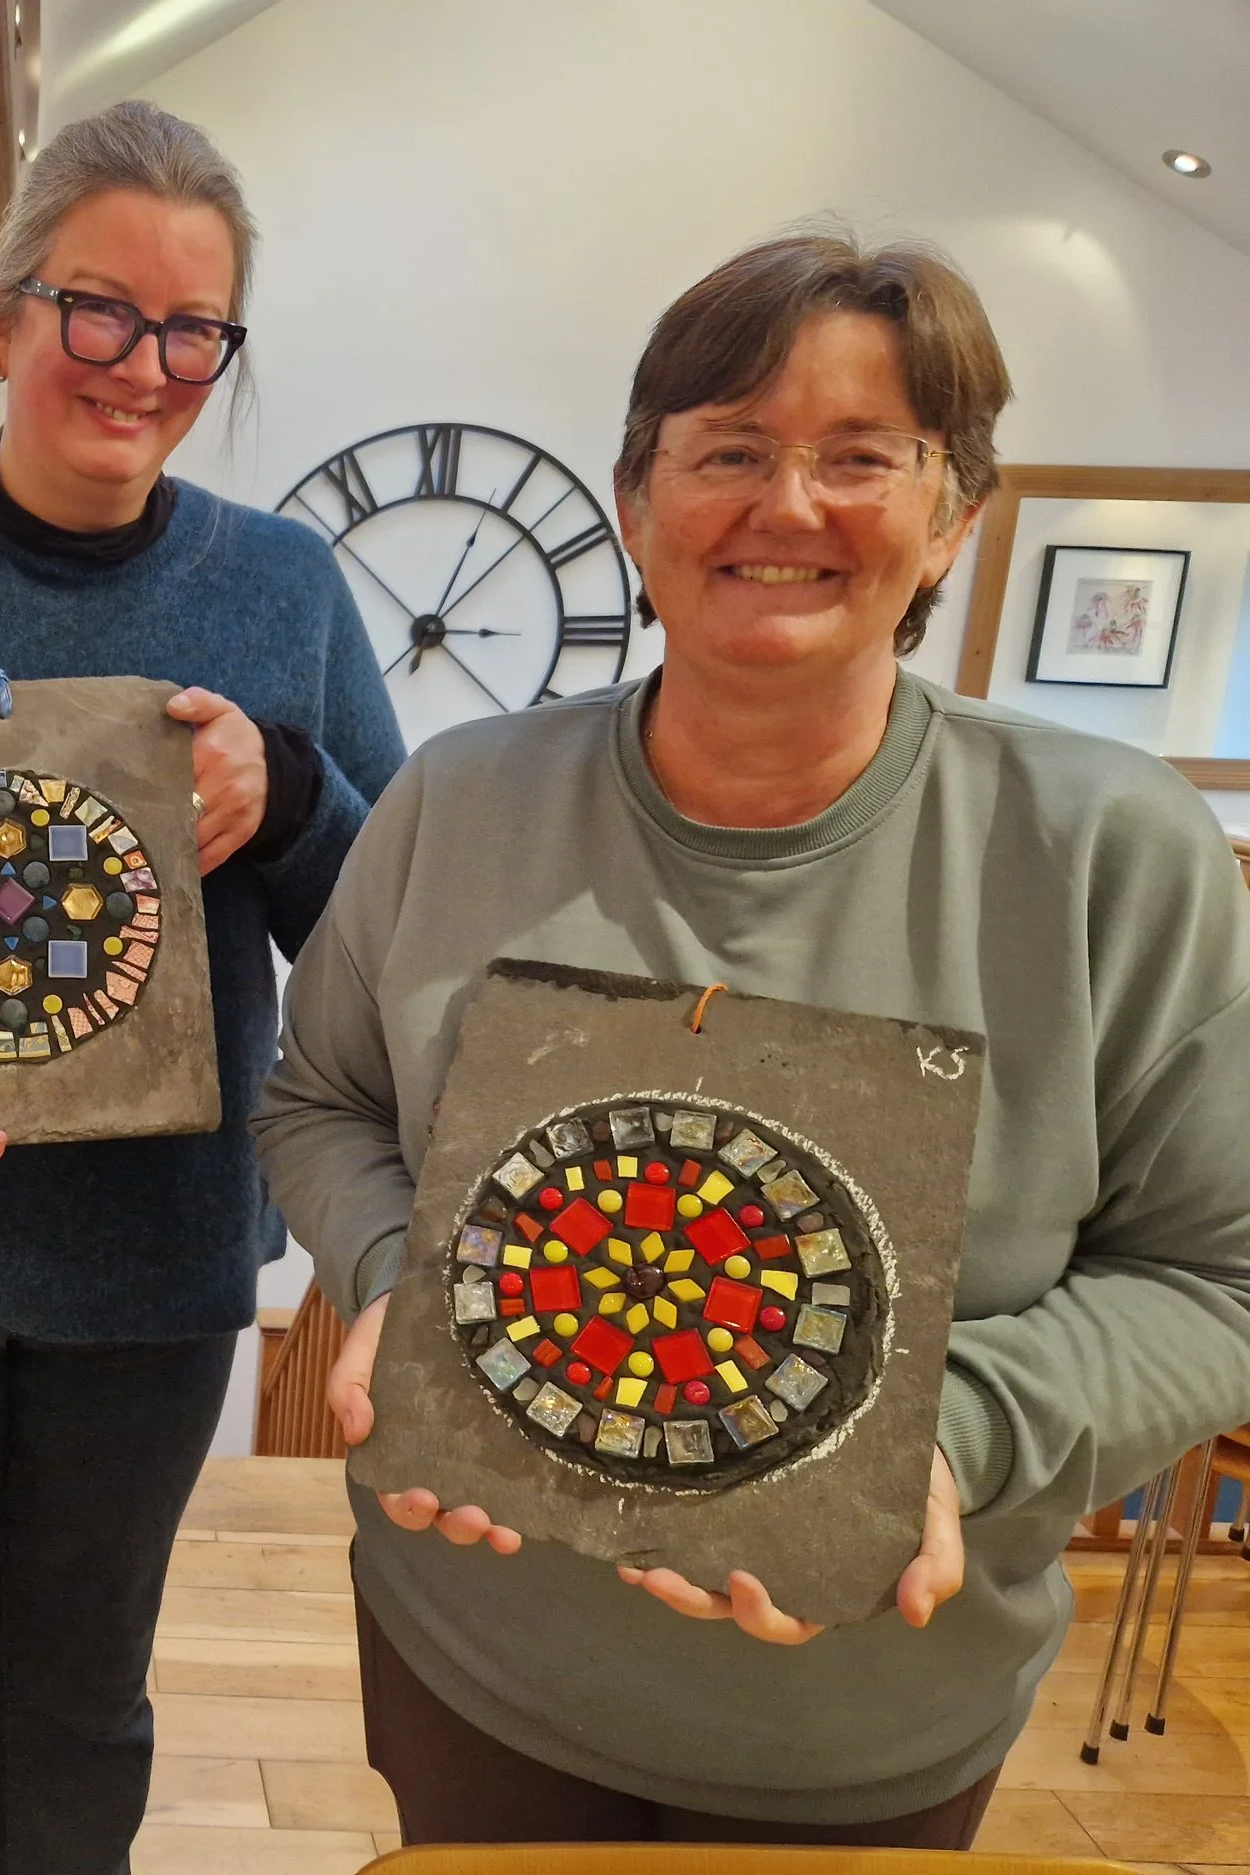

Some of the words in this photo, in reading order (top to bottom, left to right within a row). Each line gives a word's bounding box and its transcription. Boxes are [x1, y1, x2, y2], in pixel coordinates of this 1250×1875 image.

[322, 450, 379, 522] XI
[416, 425, 462, 497] XII
[545, 522, 612, 572] II
[563, 615, 627, 647] III
